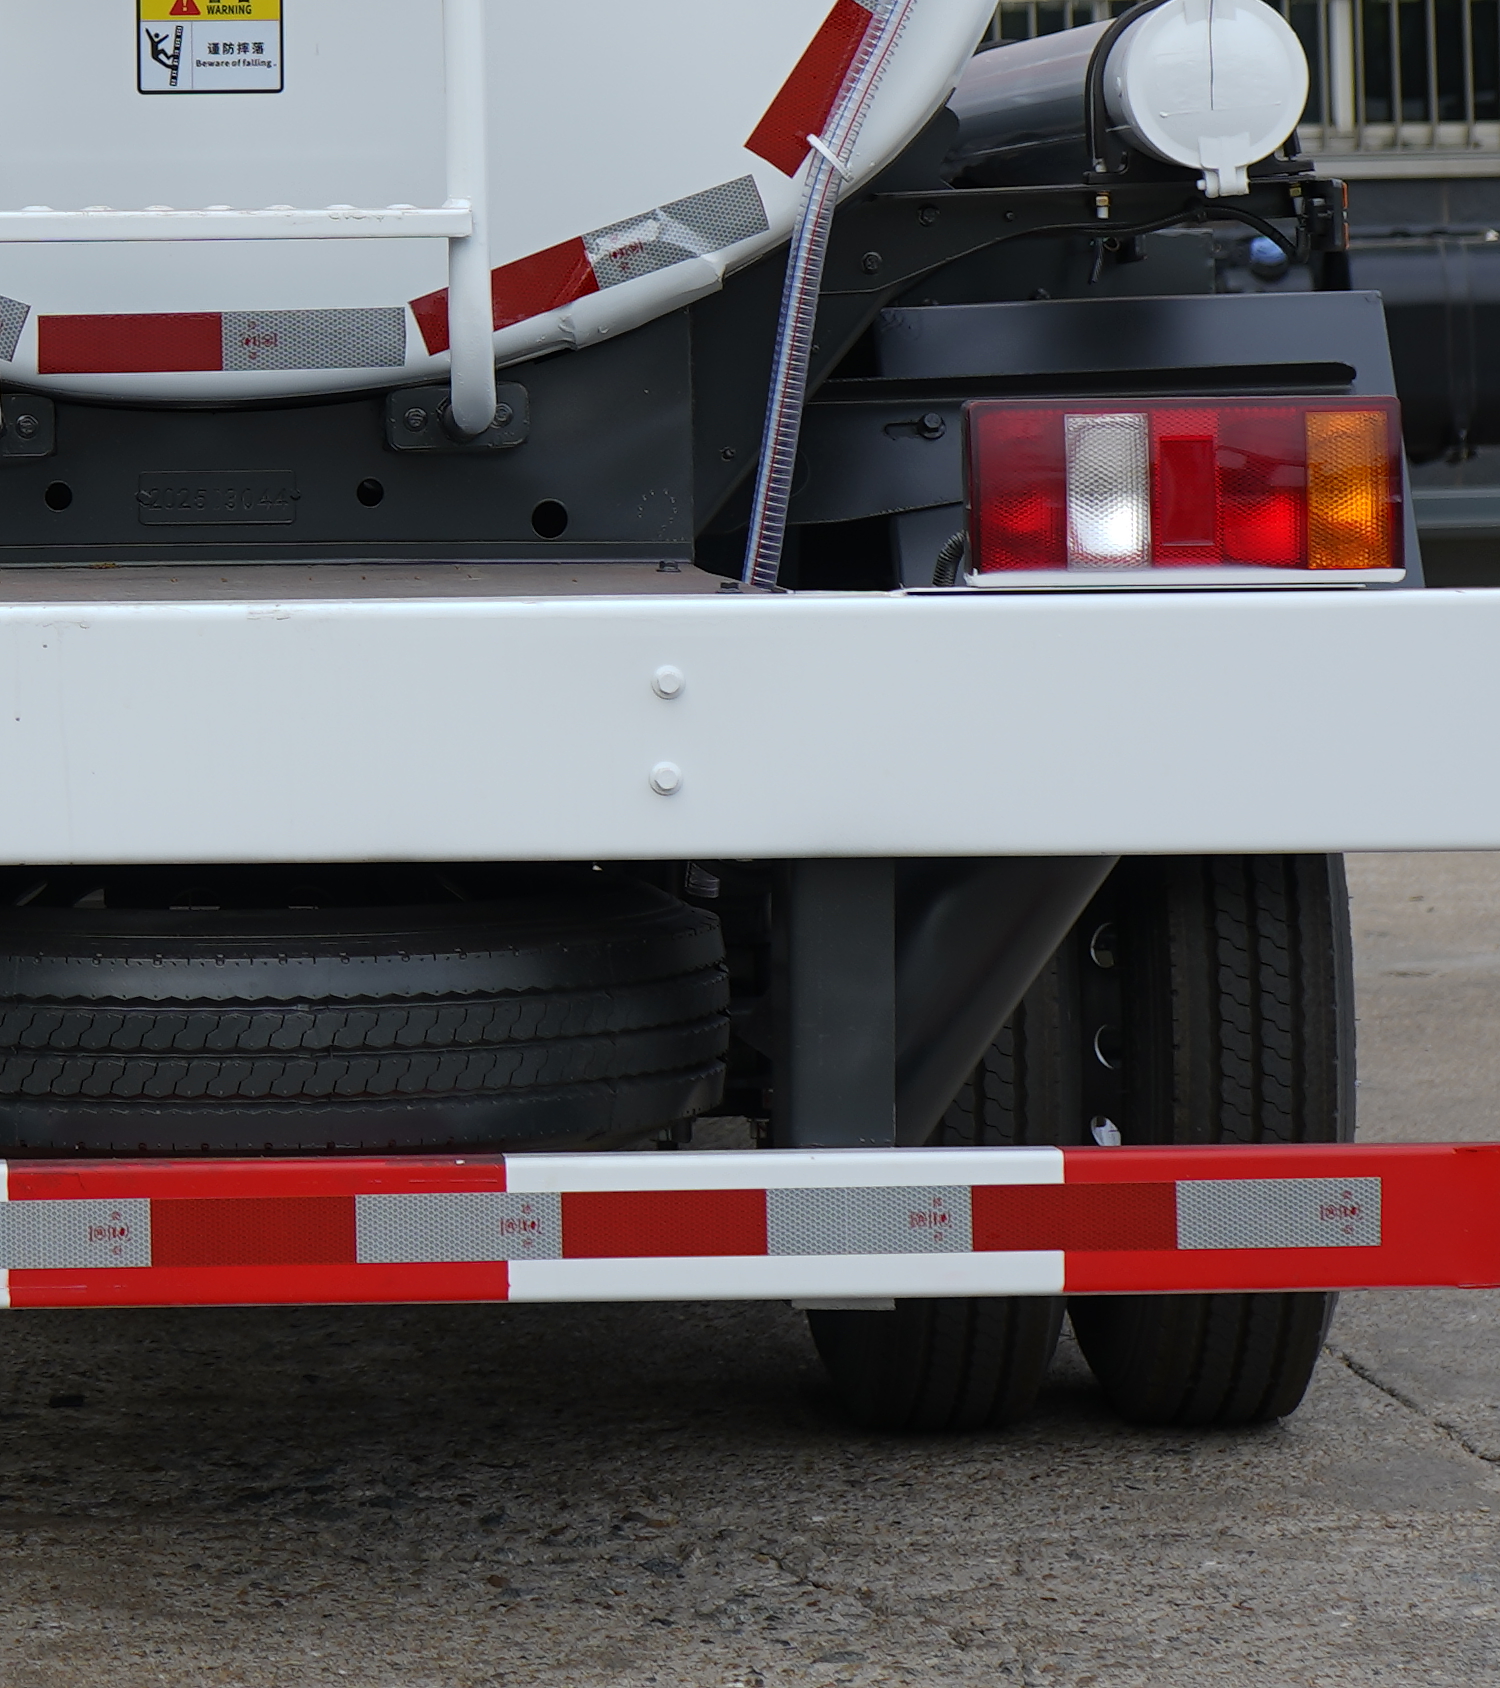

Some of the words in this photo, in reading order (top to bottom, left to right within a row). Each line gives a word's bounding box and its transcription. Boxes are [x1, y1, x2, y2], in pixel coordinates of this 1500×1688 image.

[206, 5, 252, 15] WARNING
[207, 42, 265, 55] 谨防摔落
[195, 59, 230, 68] Beware
[232, 59, 241, 67] of
